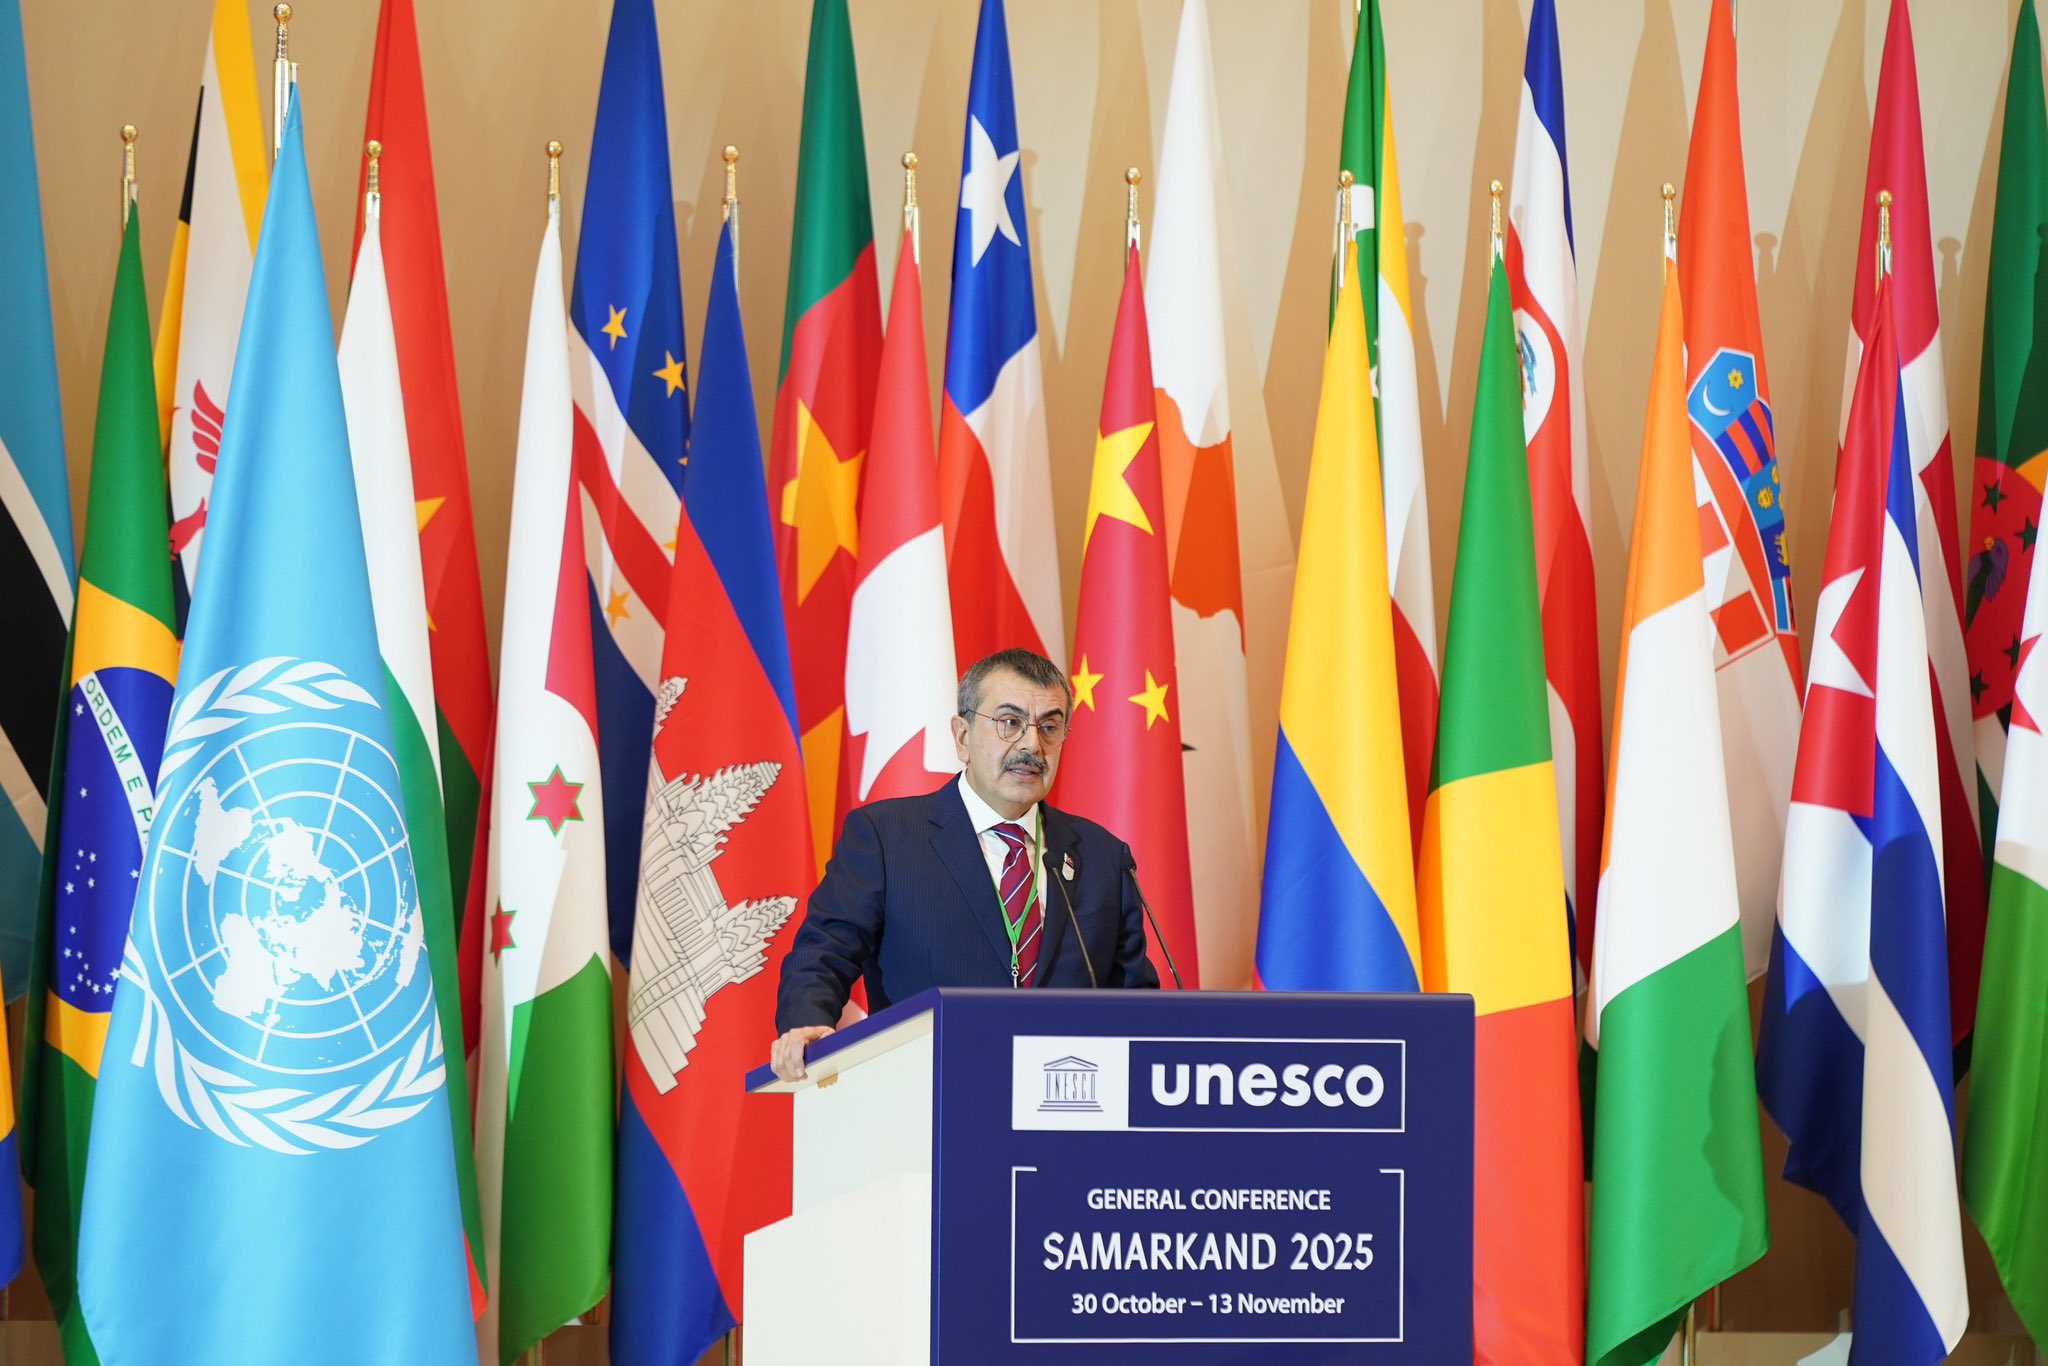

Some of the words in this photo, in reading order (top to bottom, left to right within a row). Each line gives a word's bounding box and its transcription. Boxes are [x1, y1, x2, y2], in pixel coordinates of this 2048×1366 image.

[85, 678, 133, 764] ORDEM
[126, 776, 143, 792] E
[1046, 1072, 1096, 1100] UNESCO
[1151, 1063, 1385, 1108] unesco
[1087, 1188, 1187, 1211] GENERAL
[1190, 1188, 1331, 1211] CONFERENCE
[1043, 1231, 1277, 1271] SAMARKAND
[1290, 1232, 1374, 1271] 2025
[1071, 1293, 1098, 1314] 30
[1101, 1291, 1187, 1314] October
[1208, 1293, 1233, 1314] 13
[1238, 1292, 1346, 1314] November
